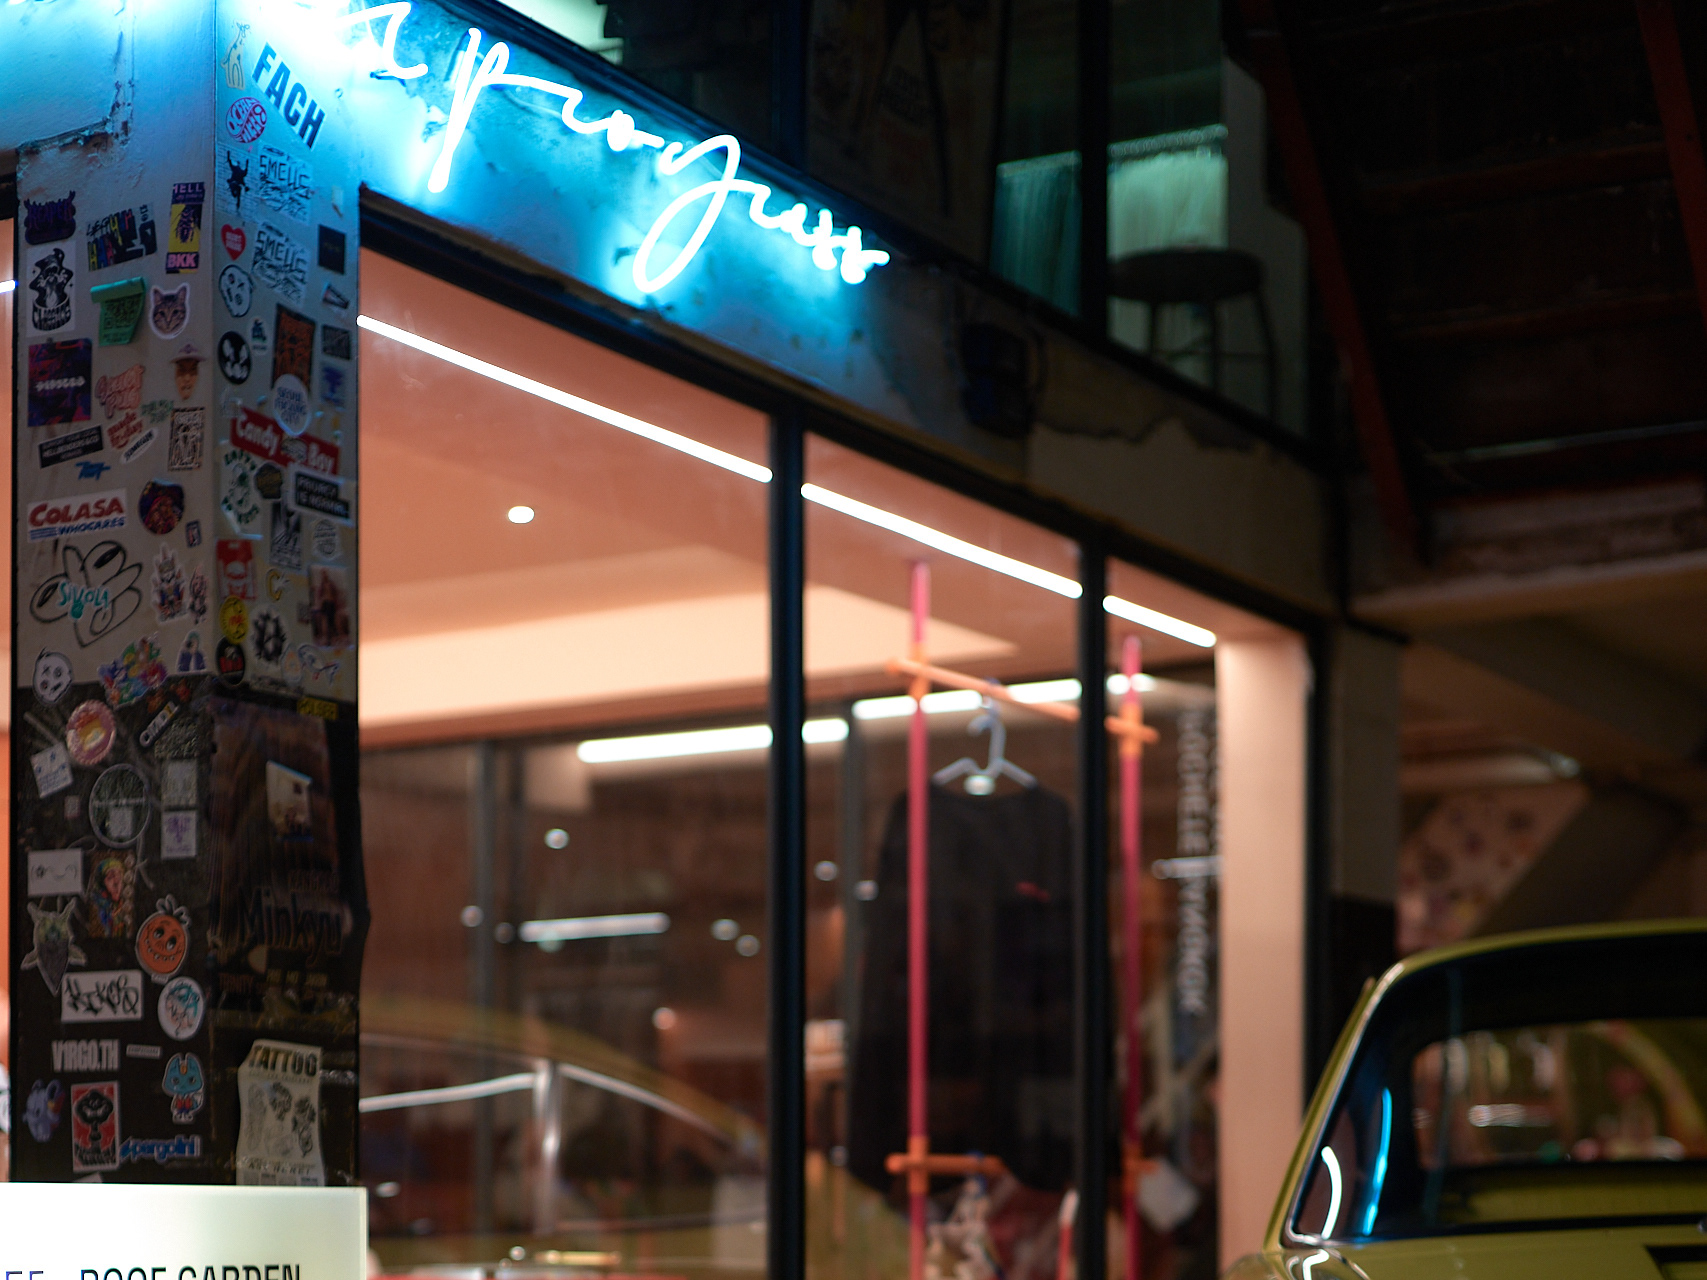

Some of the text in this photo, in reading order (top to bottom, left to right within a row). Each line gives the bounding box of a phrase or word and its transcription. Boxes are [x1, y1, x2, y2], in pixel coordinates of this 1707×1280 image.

[252, 42, 325, 149] FACH
[167, 256, 196, 268] BKK
[28, 497, 124, 527] COLASA
